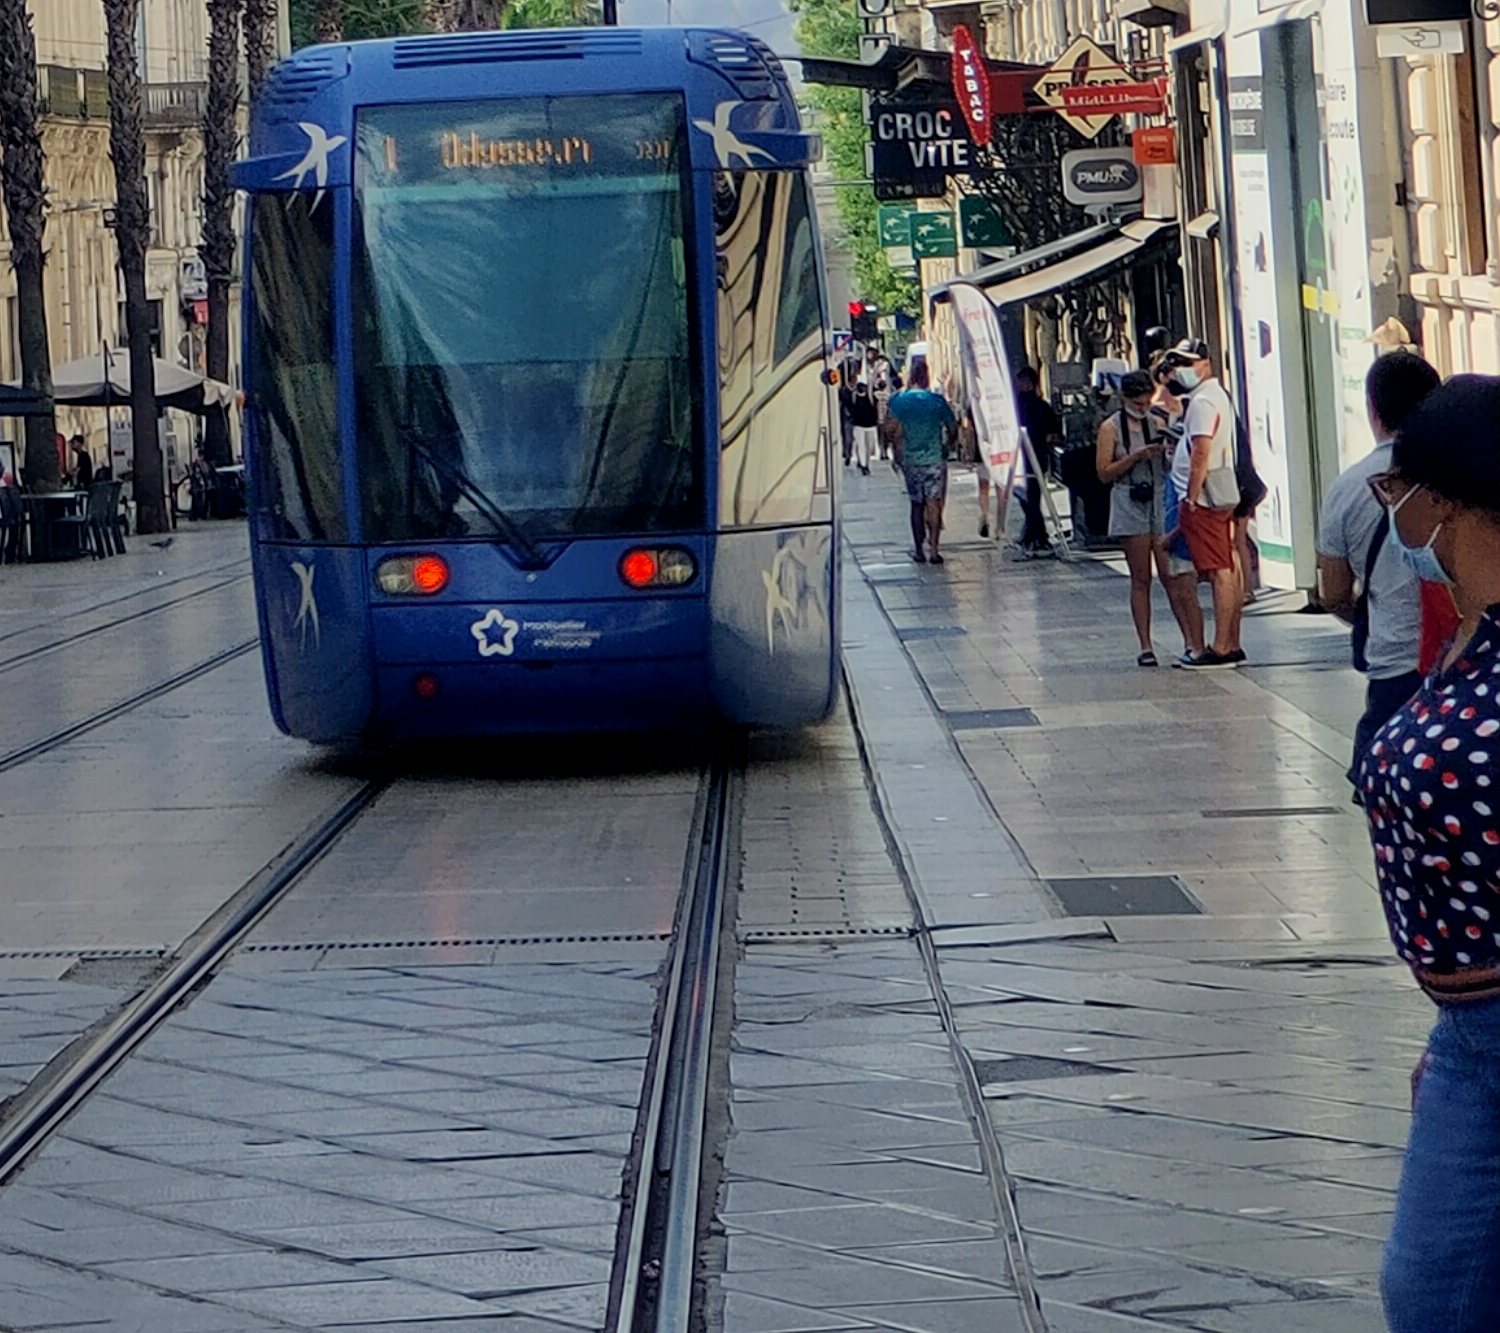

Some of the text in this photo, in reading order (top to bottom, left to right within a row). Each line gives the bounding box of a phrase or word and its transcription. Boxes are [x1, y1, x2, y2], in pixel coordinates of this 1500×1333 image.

[959, 49, 985, 122] TABAC
[878, 110, 953, 140] CROC
[1077, 170, 1110, 184] PMU
